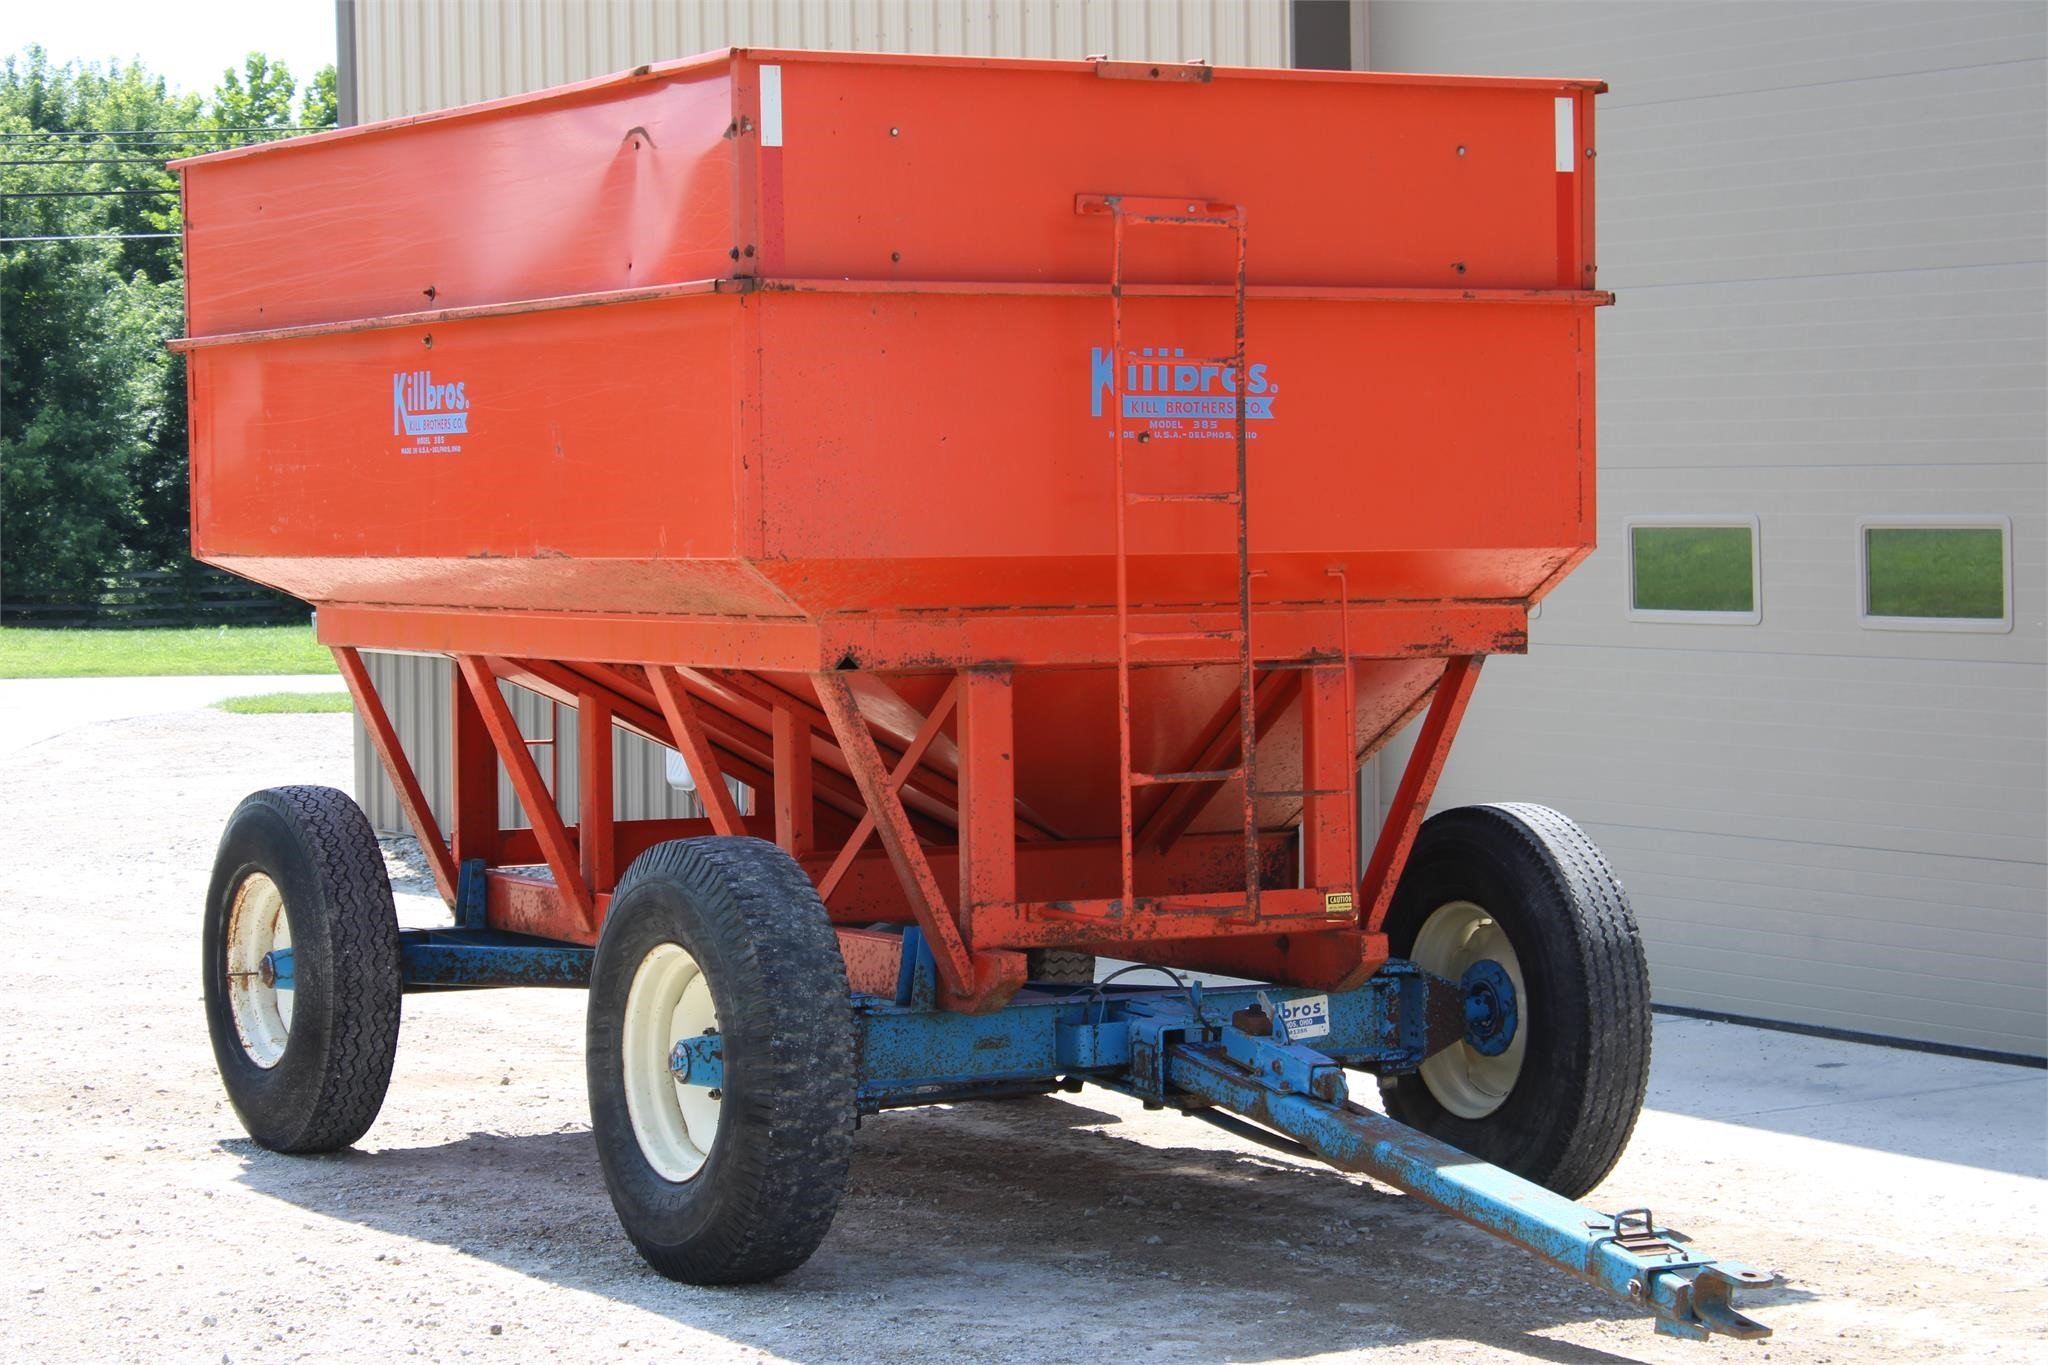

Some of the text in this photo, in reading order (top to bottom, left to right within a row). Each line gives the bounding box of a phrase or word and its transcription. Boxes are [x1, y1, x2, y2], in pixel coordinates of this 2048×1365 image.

[1131, 402, 1158, 413] KILL
[1166, 402, 1234, 414] BROTHERS
[423, 418, 451, 430] BROTHERS
[1149, 420, 1183, 429] MODEL
[1282, 1002, 1321, 1018] bros
